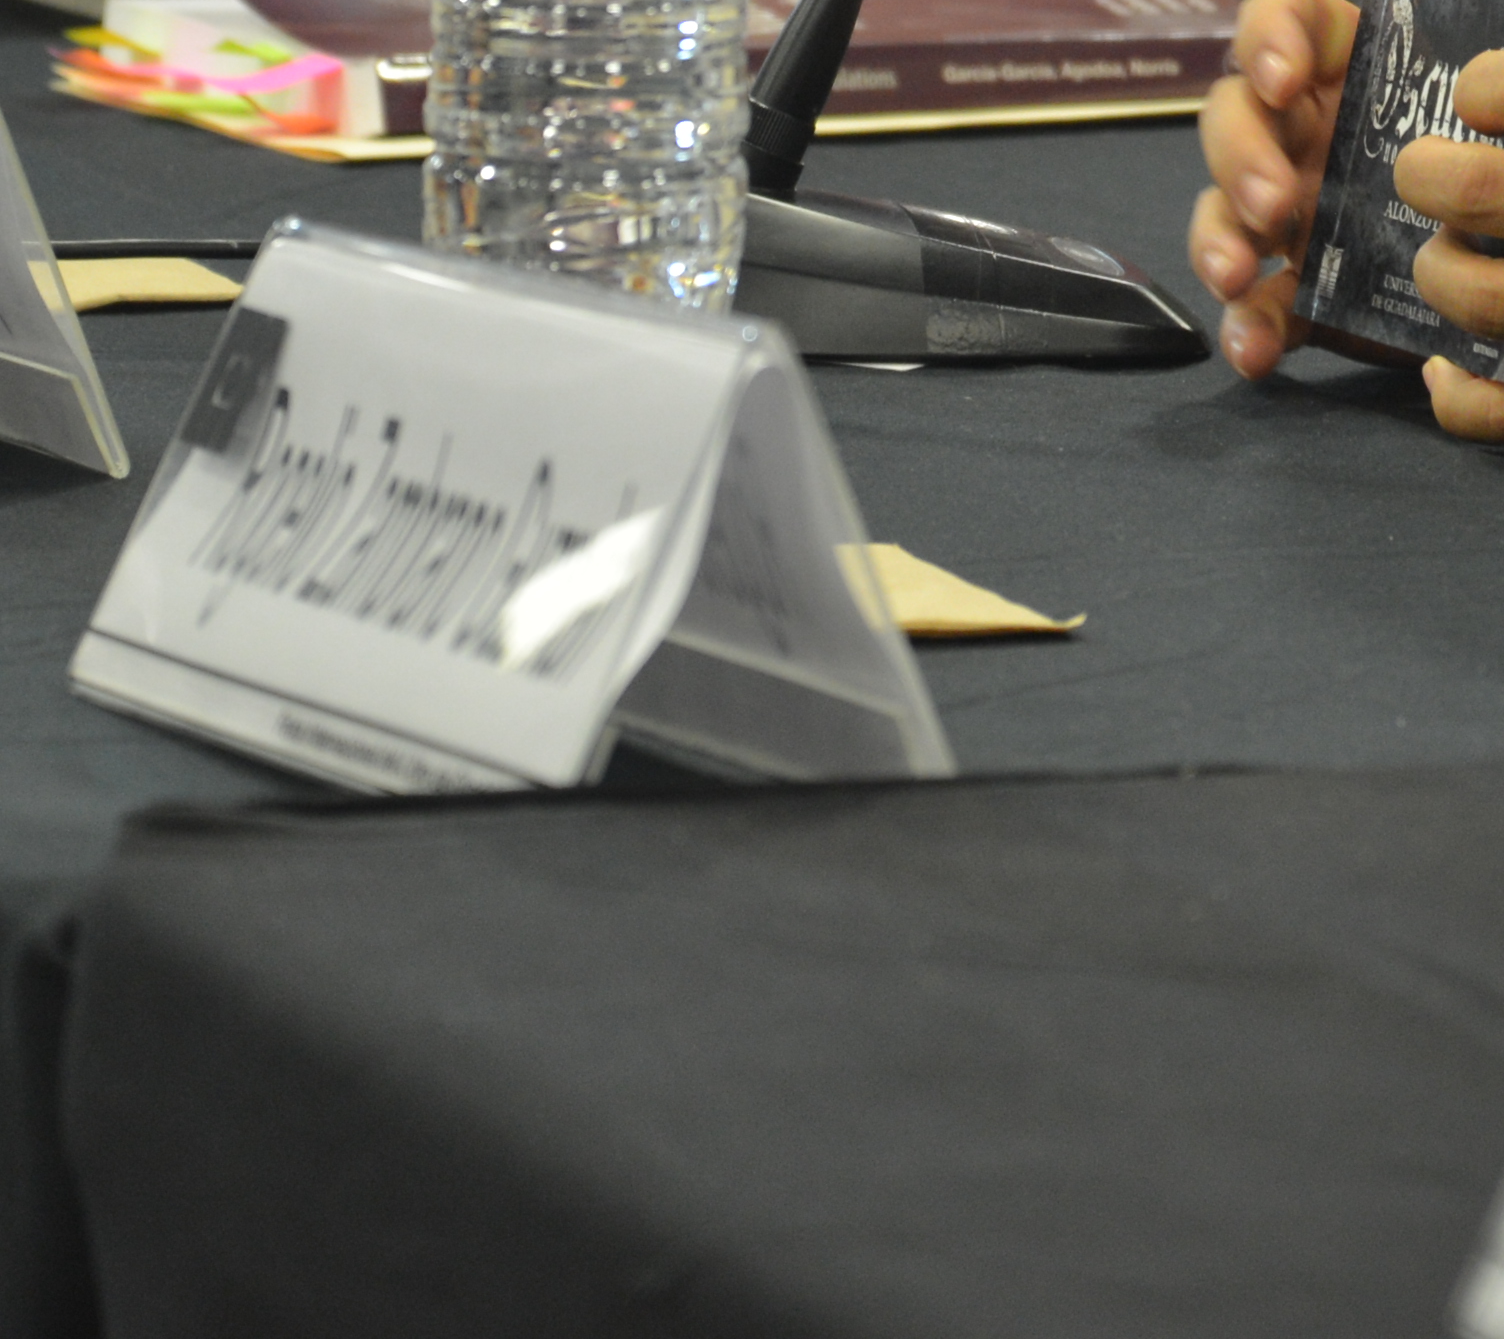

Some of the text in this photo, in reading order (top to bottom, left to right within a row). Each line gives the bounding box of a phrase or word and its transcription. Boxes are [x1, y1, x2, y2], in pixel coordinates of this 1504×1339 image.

[1383, 298, 1440, 327] GUADALAJARA
[187, 386, 358, 630] Rogelio
[297, 416, 507, 643] Zambrano
